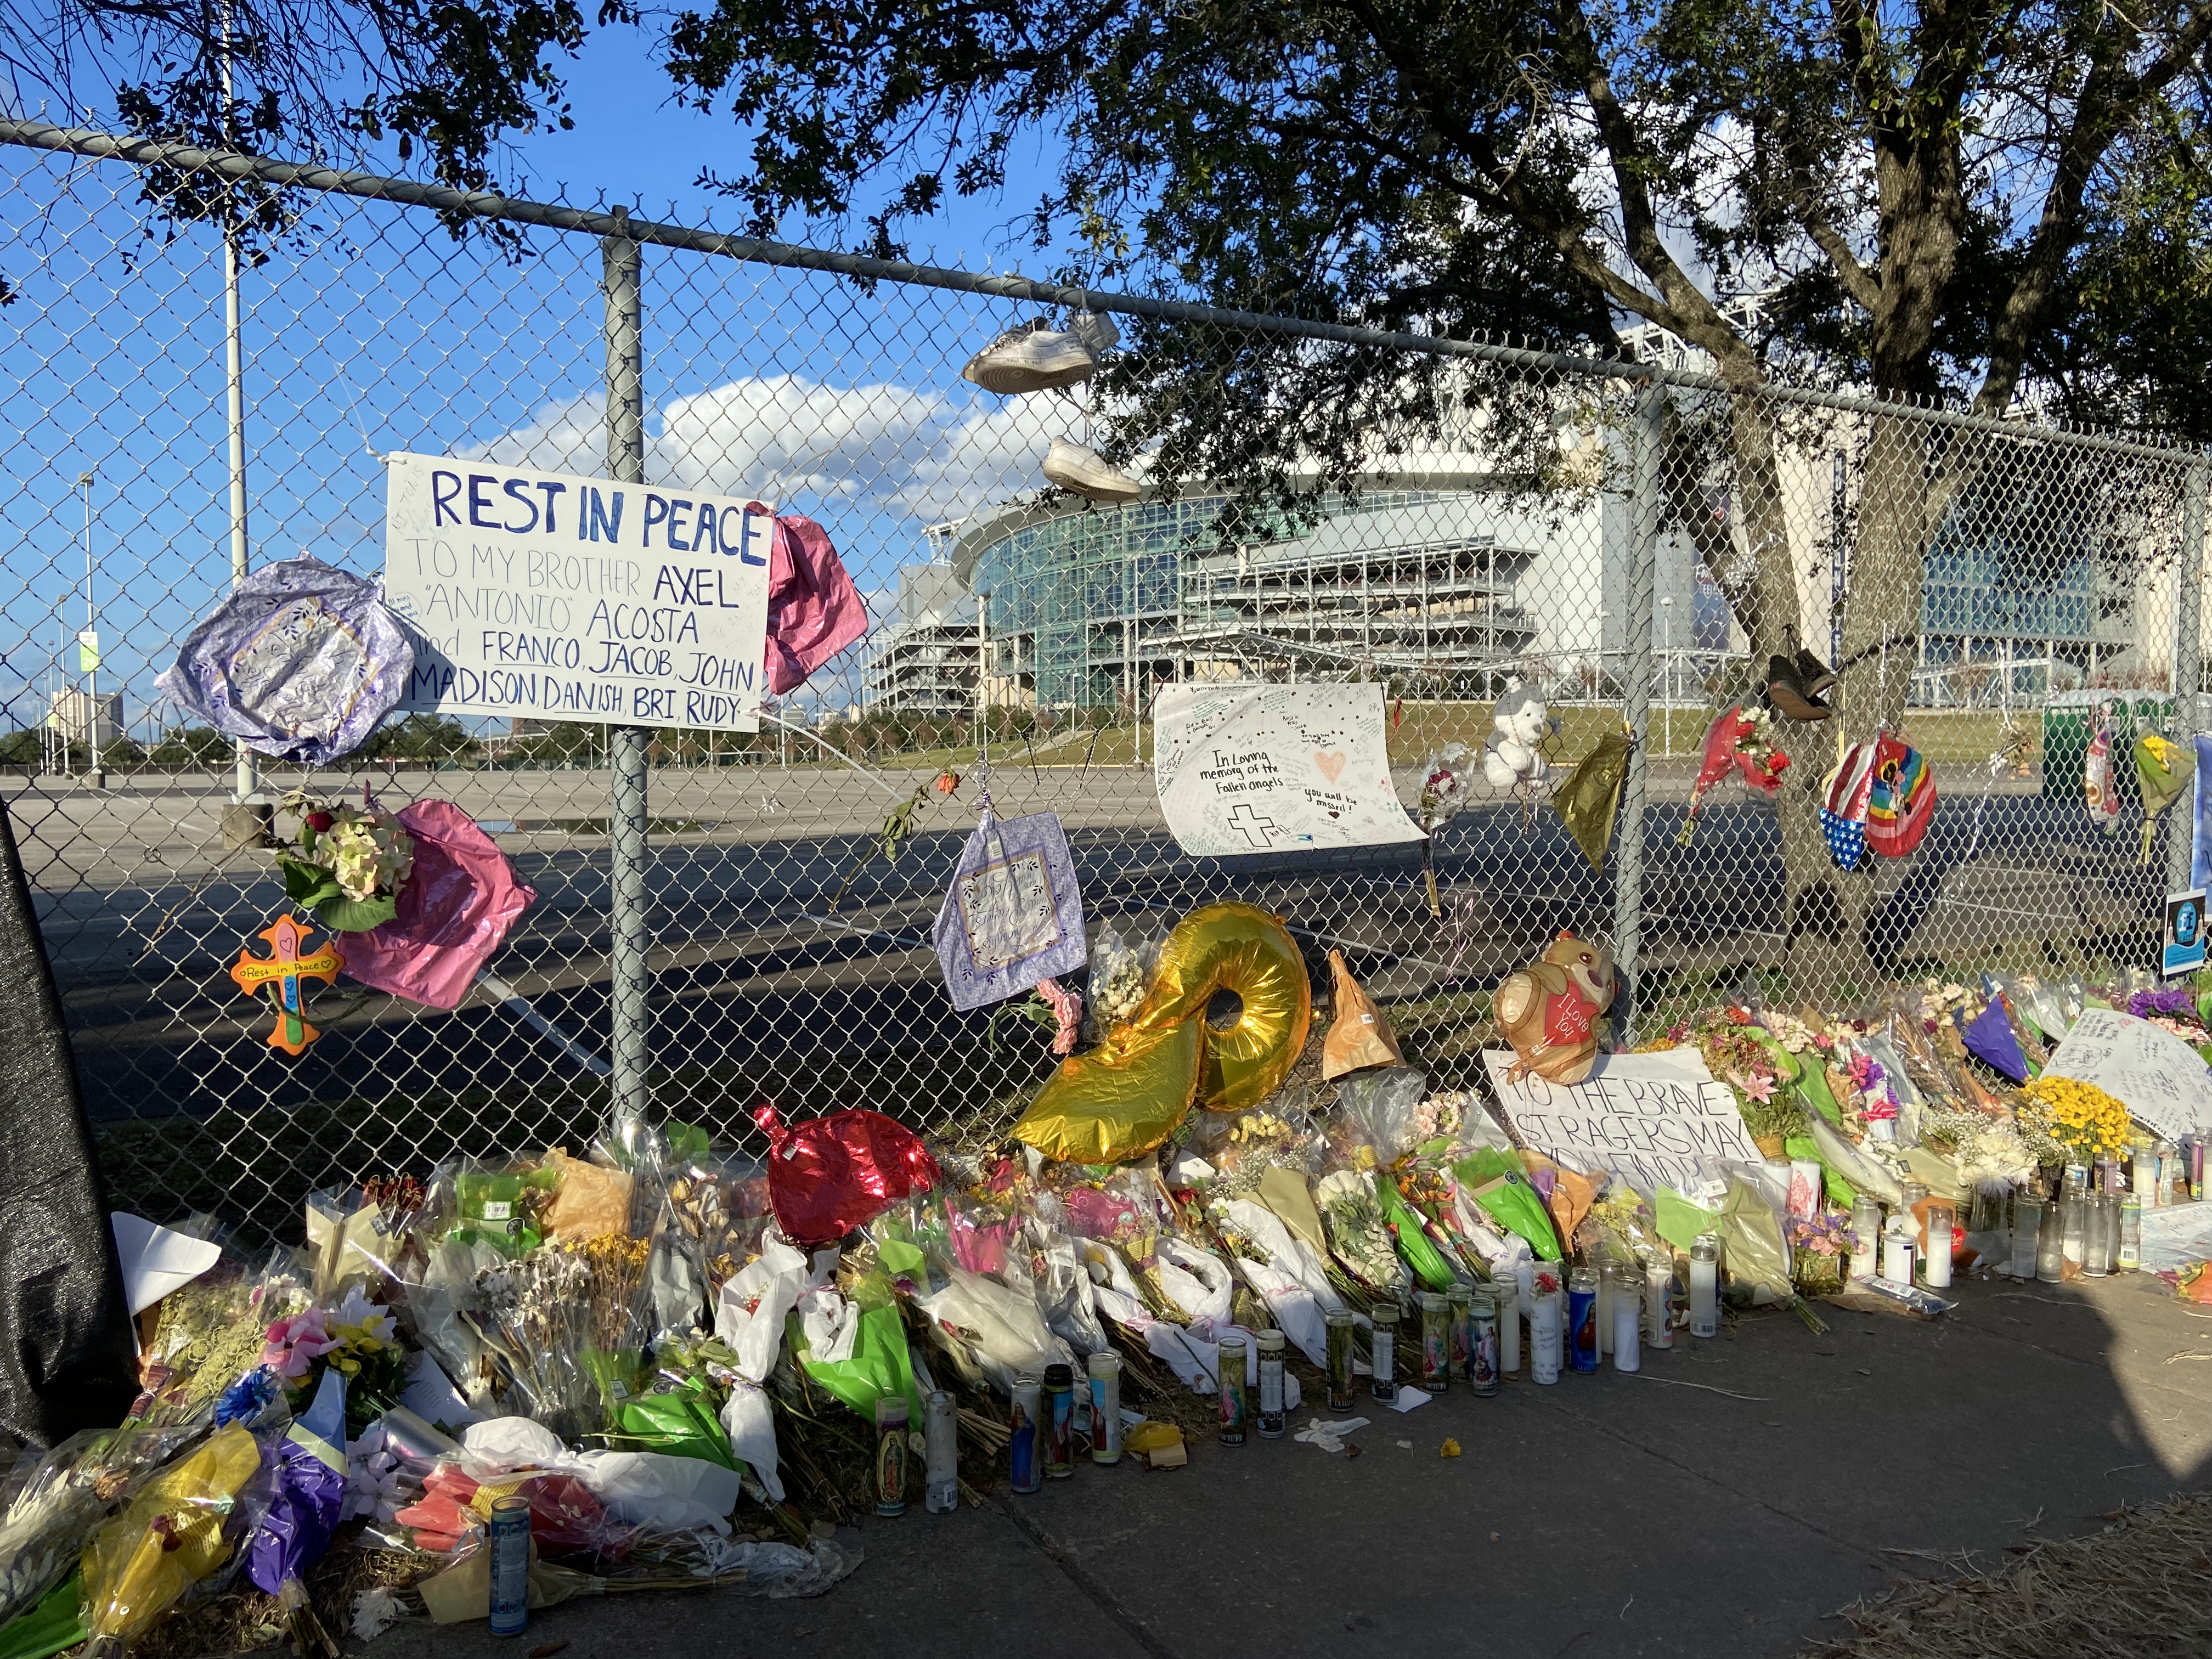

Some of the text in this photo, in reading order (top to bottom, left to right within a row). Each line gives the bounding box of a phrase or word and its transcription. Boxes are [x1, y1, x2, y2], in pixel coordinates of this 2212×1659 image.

[432, 470, 567, 534] REST
[579, 486, 624, 543] IN
[643, 494, 766, 566] PEACE
[404, 539, 739, 608] TO MY BROTHER AXEL
[426, 583, 573, 631] "ANTONIO"
[586, 599, 698, 644] ACOSTA
[410, 628, 460, 657] and
[686, 691, 742, 724] RUDY
[1212, 749, 1271, 768] In Loving
[1261, 764, 1279, 774] the
[1215, 782, 1248, 794] Fallen
[1249, 776, 1284, 792] angels
[1305, 788, 1357, 805] you will be
[246, 963, 319, 978] Rest in Peace
[1555, 1012, 1575, 1039] You
[1557, 992, 1589, 1033] I Love
[1516, 1114, 1752, 1159] ST RAGERS MAY
